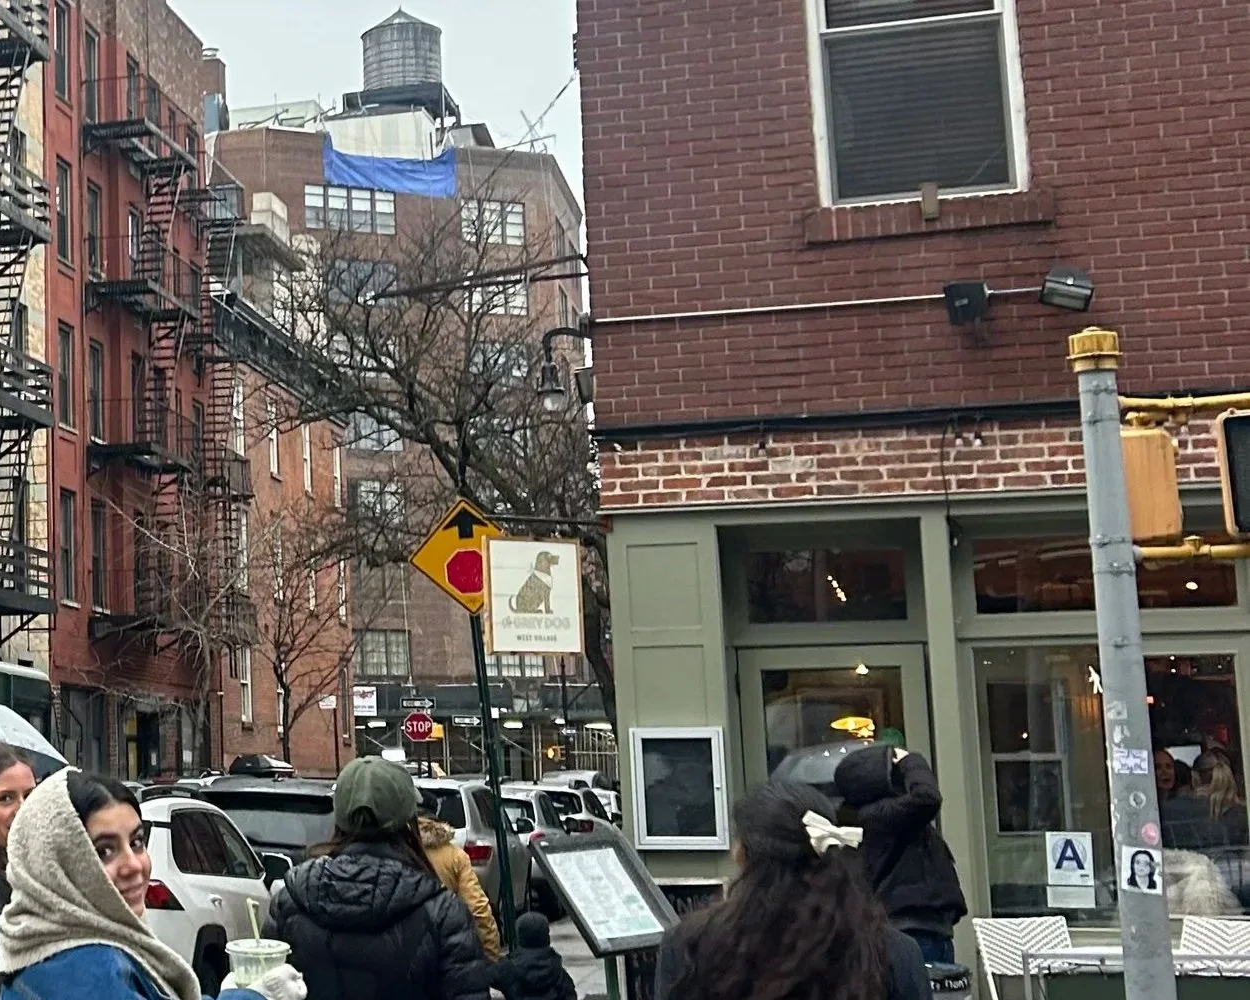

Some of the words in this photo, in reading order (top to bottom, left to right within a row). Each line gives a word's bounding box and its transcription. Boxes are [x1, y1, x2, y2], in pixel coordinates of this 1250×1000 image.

[545, 617, 571, 630] DOG
[406, 721, 431, 732] STOP
[1055, 838, 1085, 870] A
